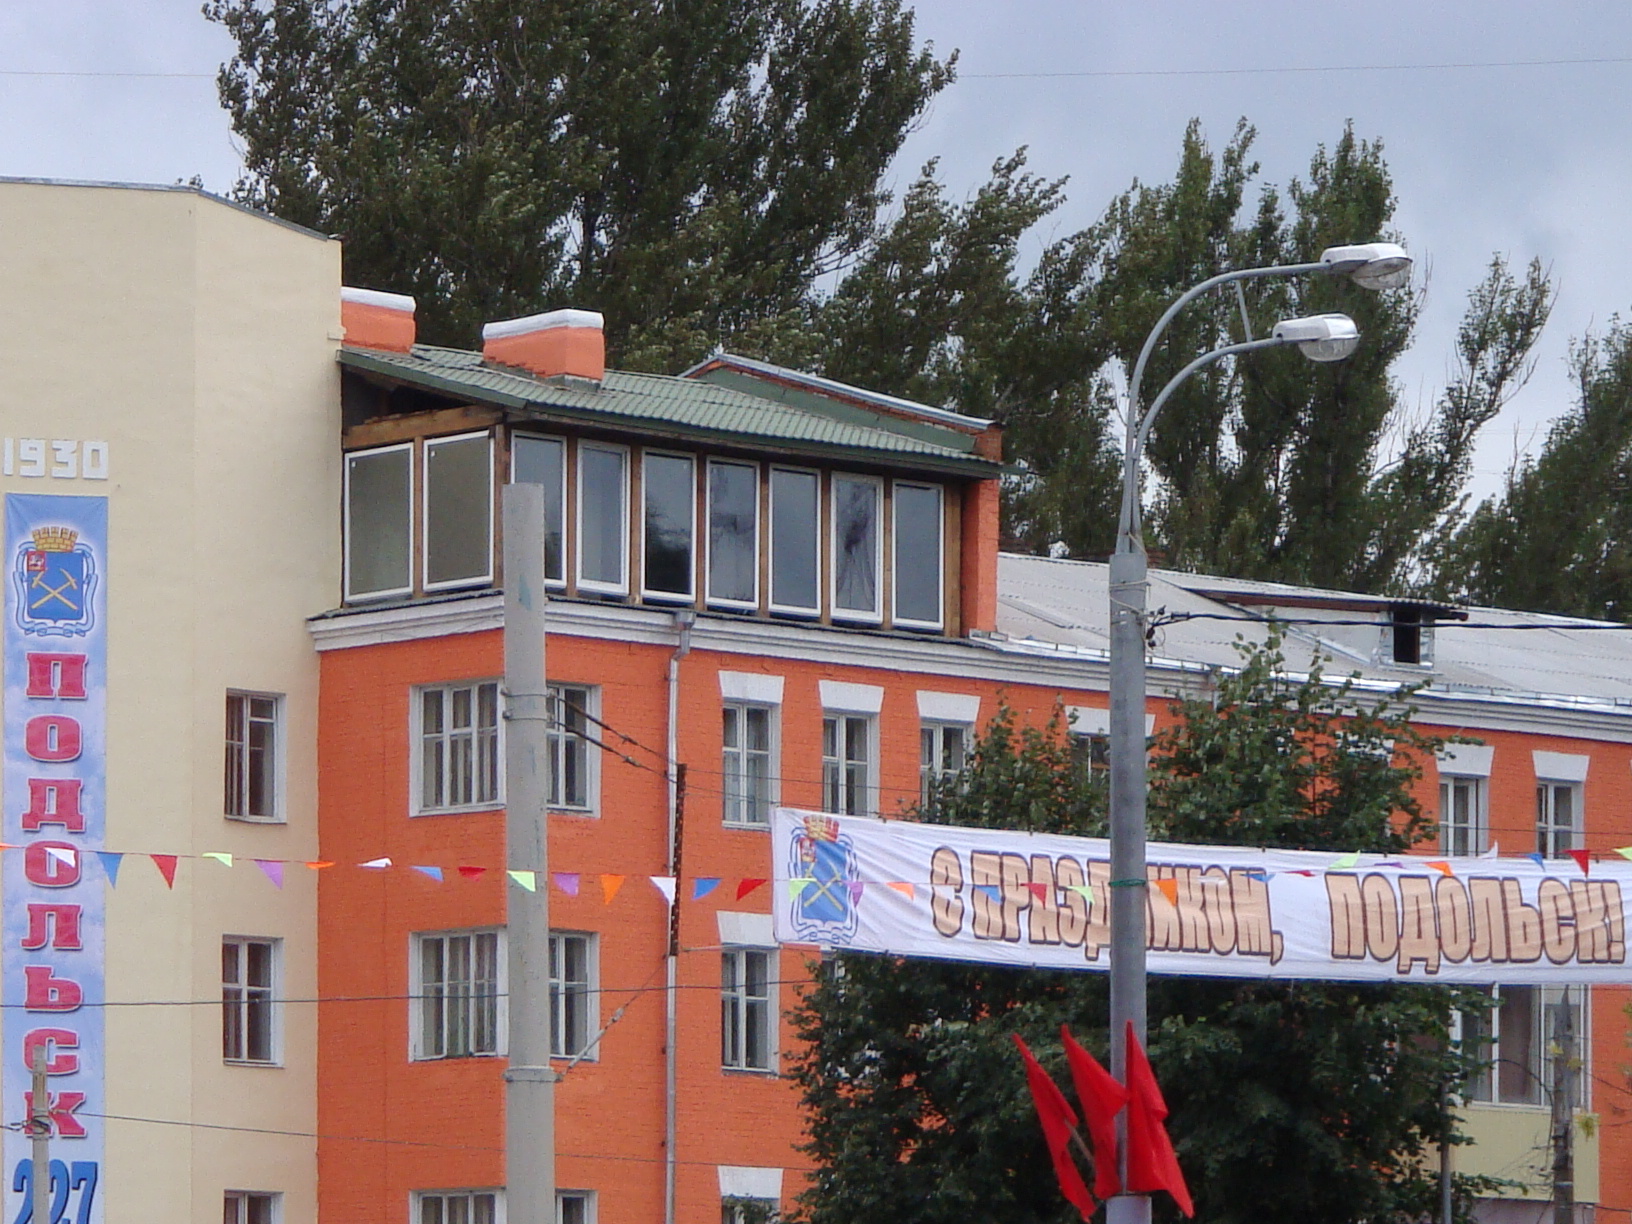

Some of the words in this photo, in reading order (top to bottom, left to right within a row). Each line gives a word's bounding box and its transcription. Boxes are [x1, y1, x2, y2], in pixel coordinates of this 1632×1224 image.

[3, 437, 109, 480] 1930
[21, 651, 88, 1139] ПОДОЛЬСК
[931, 846, 965, 938] С
[970, 850, 1284, 966] ПРАЗДИКОМ,
[1324, 871, 1626, 975] ПОДОЛЬСК!
